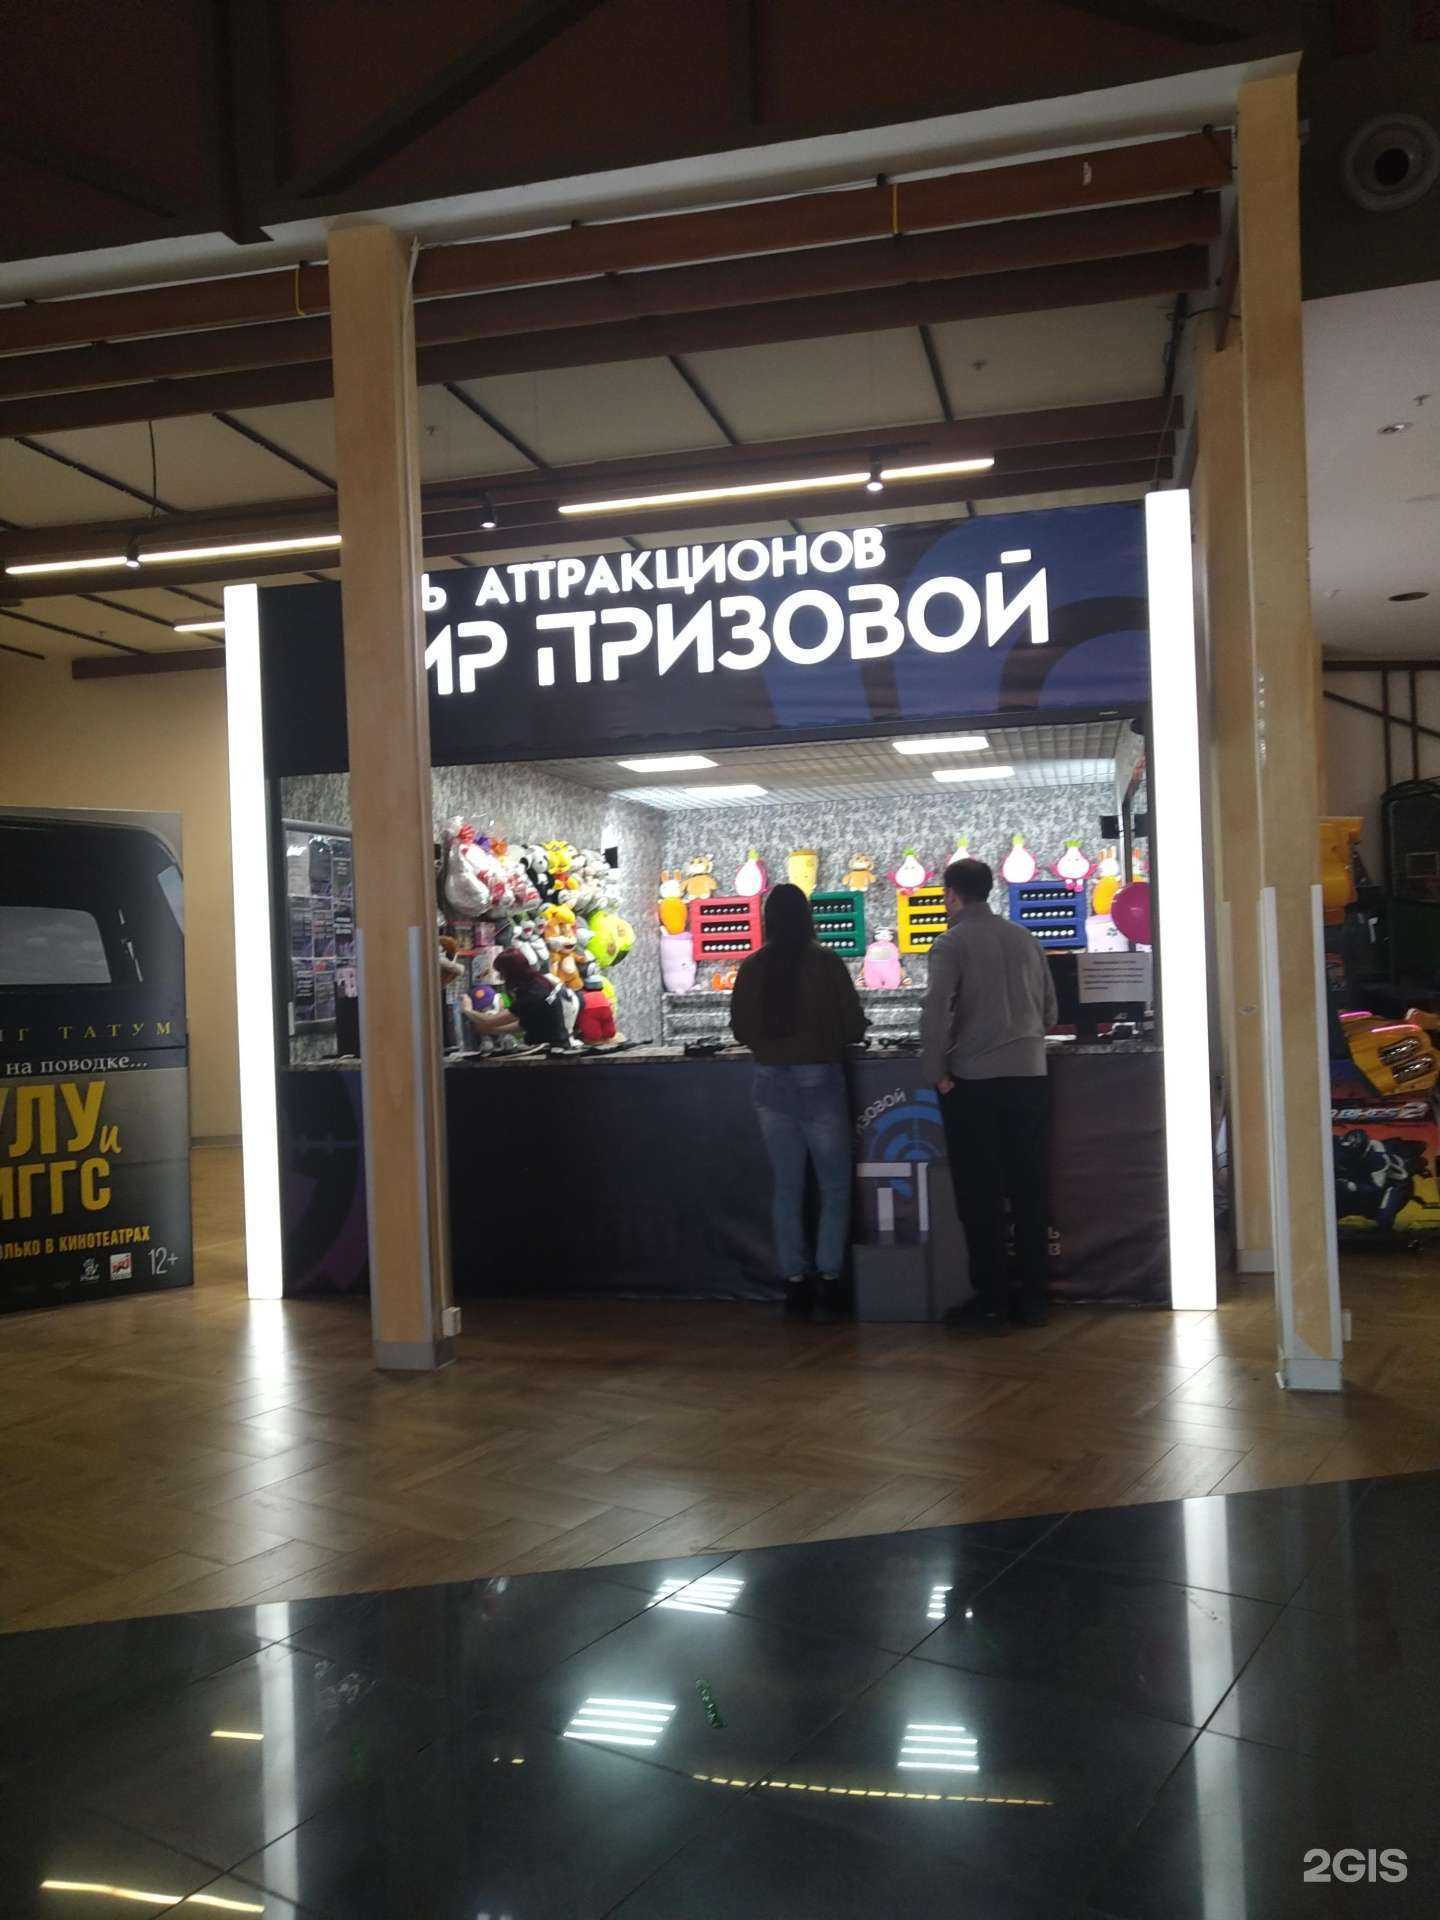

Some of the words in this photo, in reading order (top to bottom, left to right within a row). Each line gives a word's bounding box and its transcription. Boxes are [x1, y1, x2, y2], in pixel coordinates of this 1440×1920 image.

[475, 528, 886, 606] АТТРАКЦИОНОВ
[535, 548, 1051, 687] ПРИЗОВОЙ
[57, 1022, 171, 1039] ТАТУМ
[6, 1061, 33, 1076] на
[0, 1080, 106, 1159] ЛУ
[45, 1237, 55, 1255] В
[59, 1225, 151, 1252] КИНОТЕАТРАХ
[147, 1246, 179, 1276] 12+
